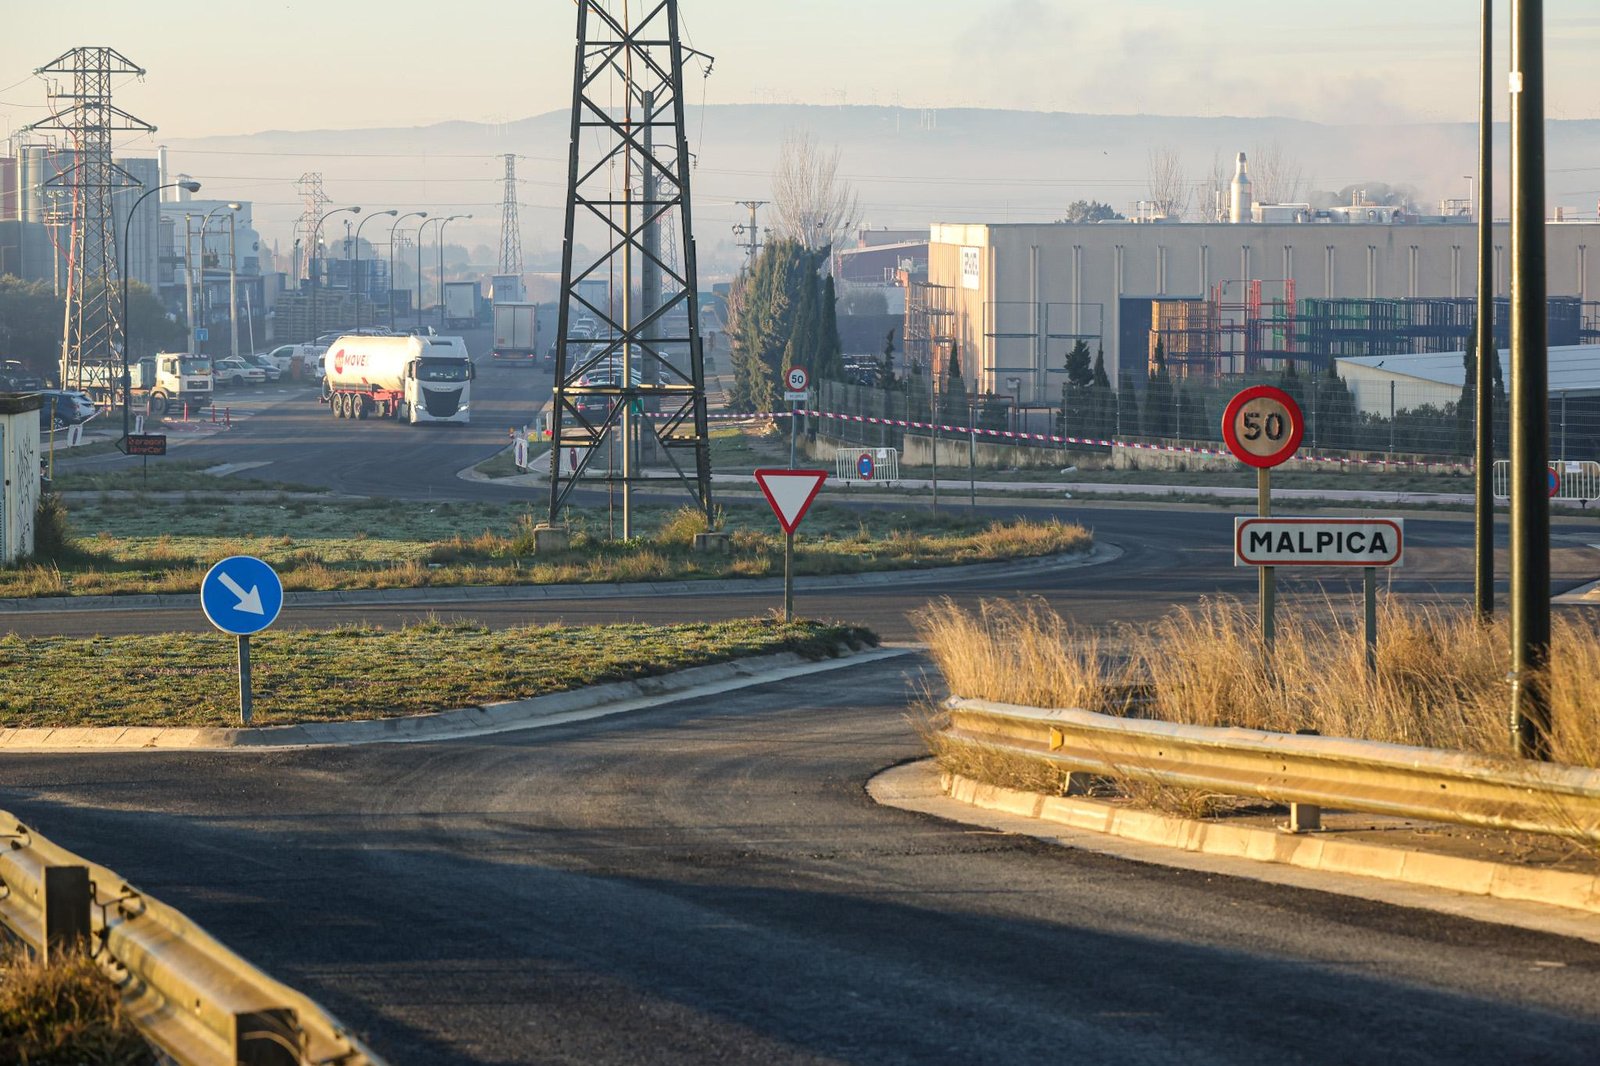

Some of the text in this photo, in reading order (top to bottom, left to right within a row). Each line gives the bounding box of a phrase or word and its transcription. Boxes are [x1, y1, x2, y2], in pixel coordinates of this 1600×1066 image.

[791, 375, 804, 384] 50
[1243, 412, 1284, 441] 50
[1249, 531, 1388, 554] MALPICA
